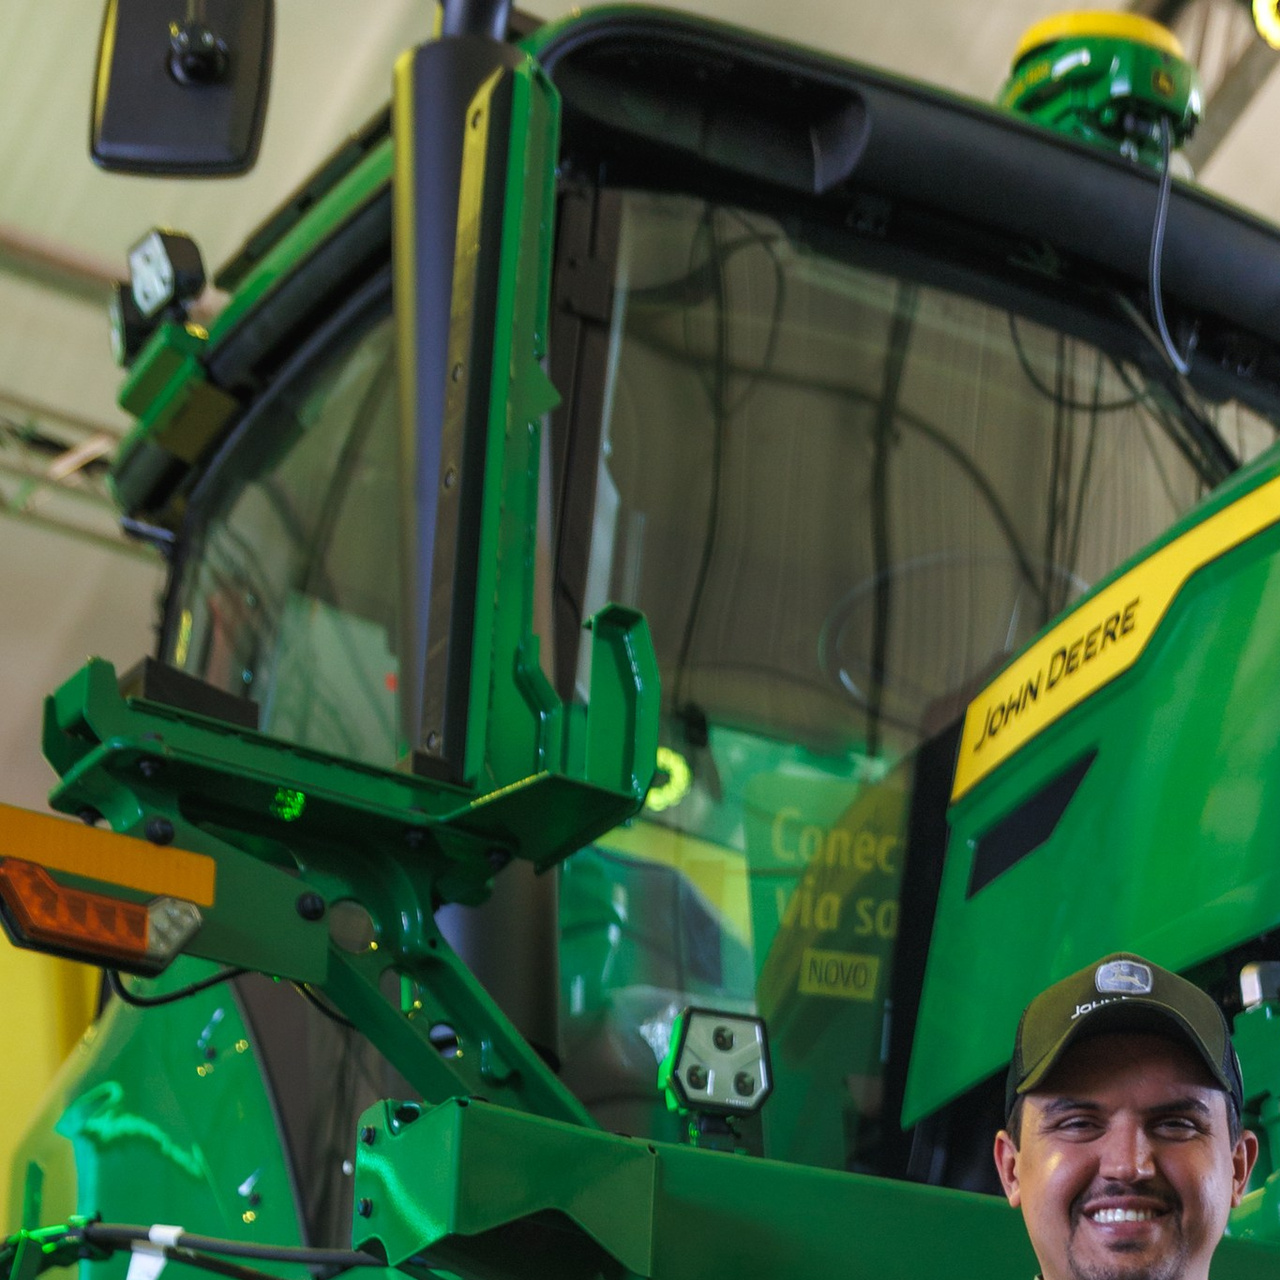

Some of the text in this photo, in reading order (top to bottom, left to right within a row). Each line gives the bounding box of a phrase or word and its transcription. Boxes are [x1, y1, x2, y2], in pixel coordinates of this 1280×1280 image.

[973, 596, 1141, 753] JOHN DEERE
[807, 957, 870, 989] NOVO
